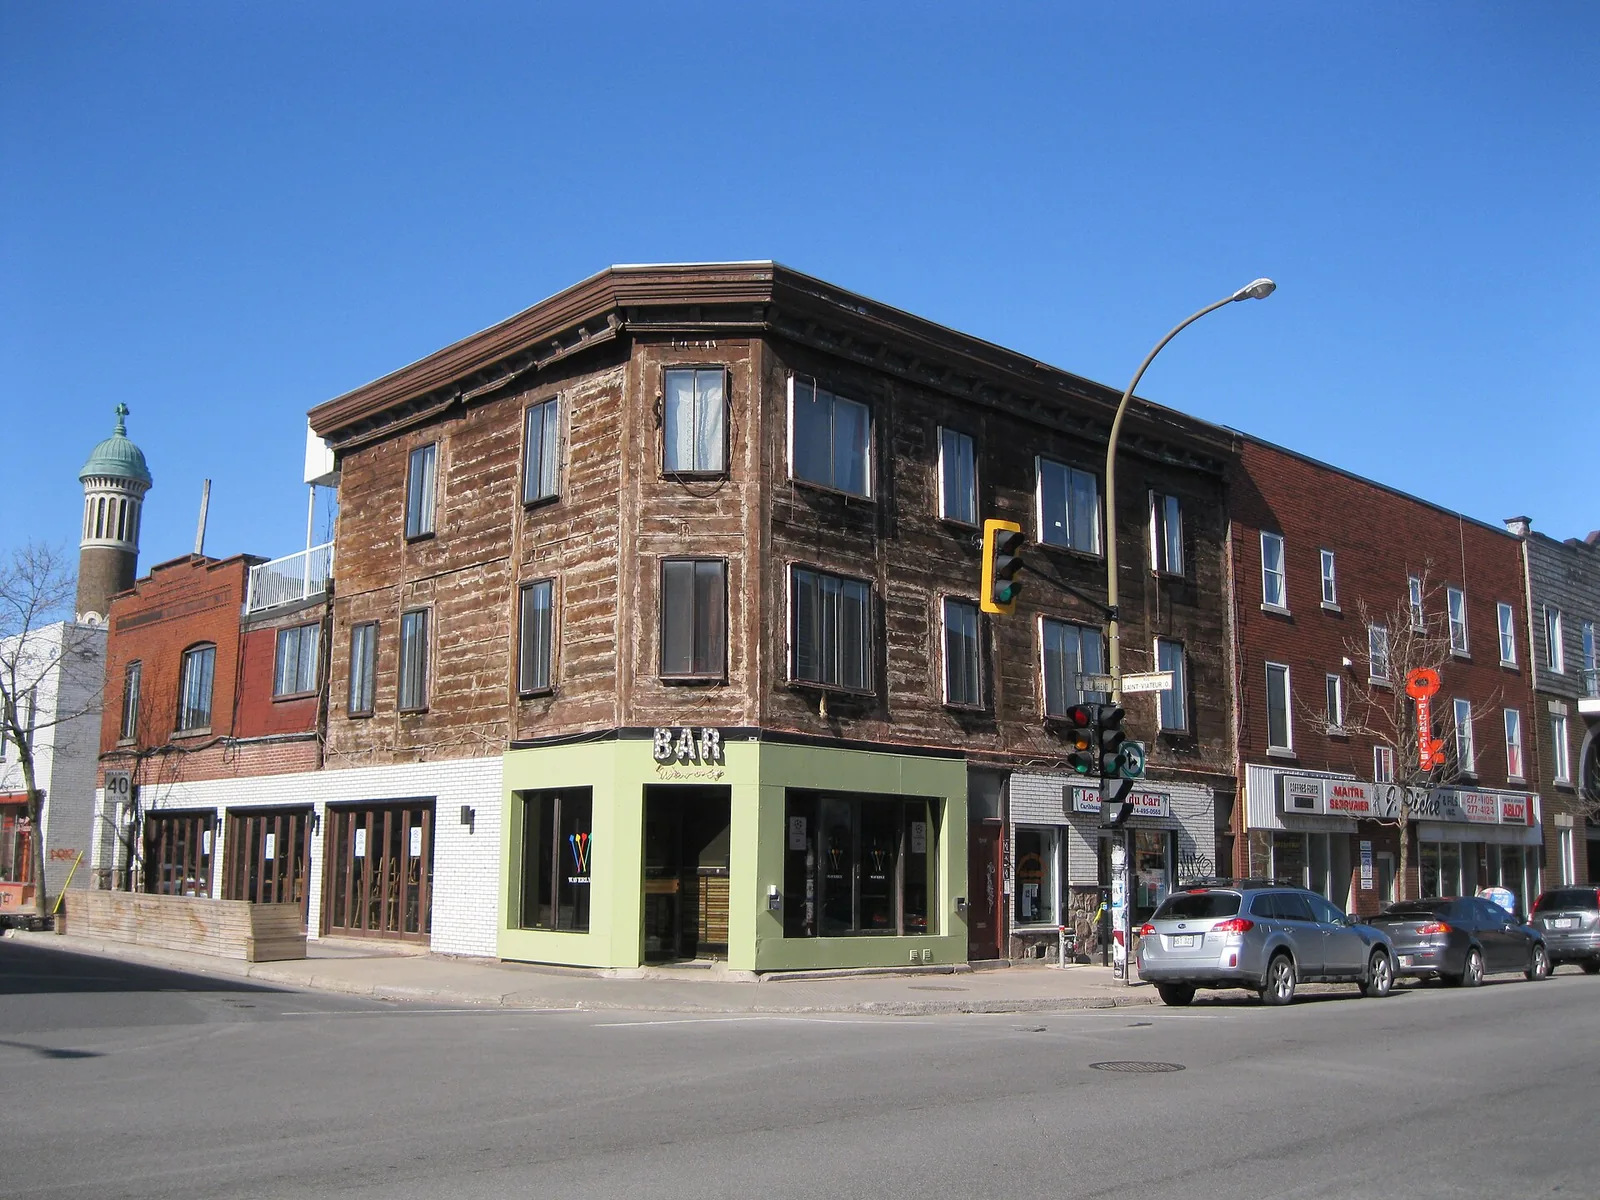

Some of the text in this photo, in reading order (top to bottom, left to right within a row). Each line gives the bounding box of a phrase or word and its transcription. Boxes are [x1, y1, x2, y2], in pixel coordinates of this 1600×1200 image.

[1123, 681, 1162, 691] SAINT-VIATEUR
[654, 727, 722, 762] BAR
[107, 777, 129, 794] 40
[1082, 790, 1094, 802] Le
[1128, 794, 1140, 806] du
[1142, 794, 1161, 807] Cari
[1503, 804, 1525, 817] ABLOY
